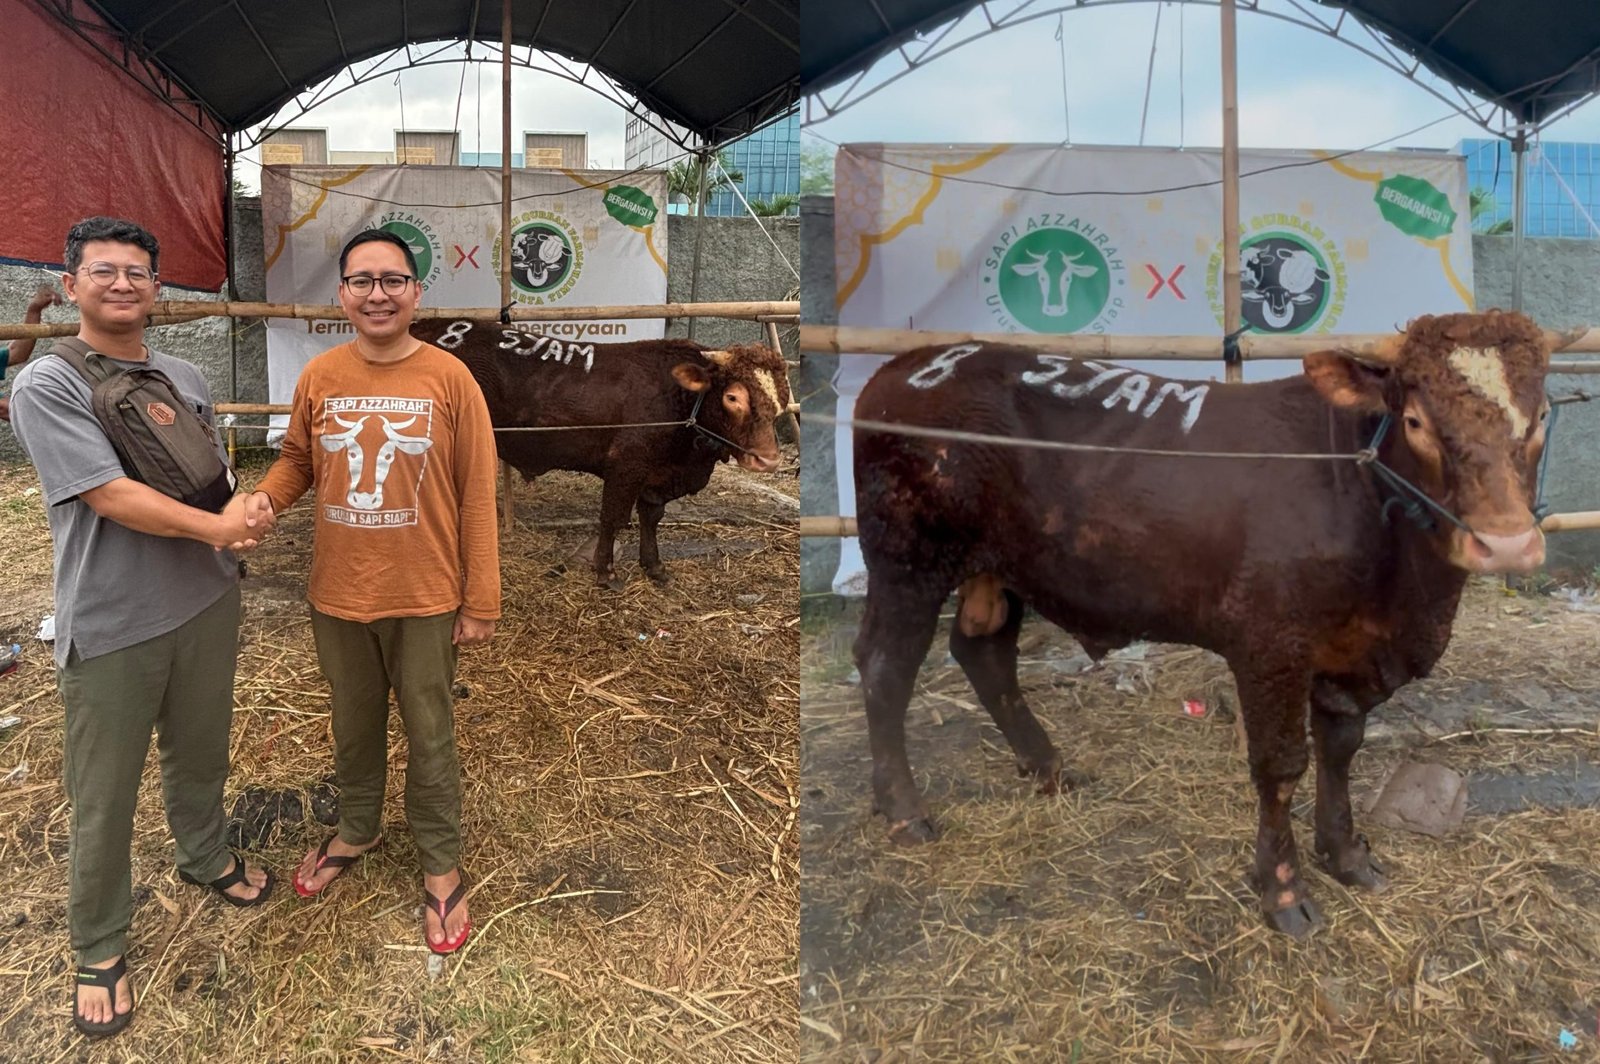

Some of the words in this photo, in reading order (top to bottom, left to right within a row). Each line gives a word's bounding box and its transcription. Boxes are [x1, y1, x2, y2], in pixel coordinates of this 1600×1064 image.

[606, 192, 648, 217] BERGARANSI
[1381, 186, 1442, 224] BERGARANSI
[380, 212, 441, 249] AZZAHRAH
[985, 226, 1019, 270] SAPI
[1026, 213, 1125, 271] AZZAHRAH
[985, 294, 1017, 333] Urus
[1092, 297, 1126, 333] Siap
